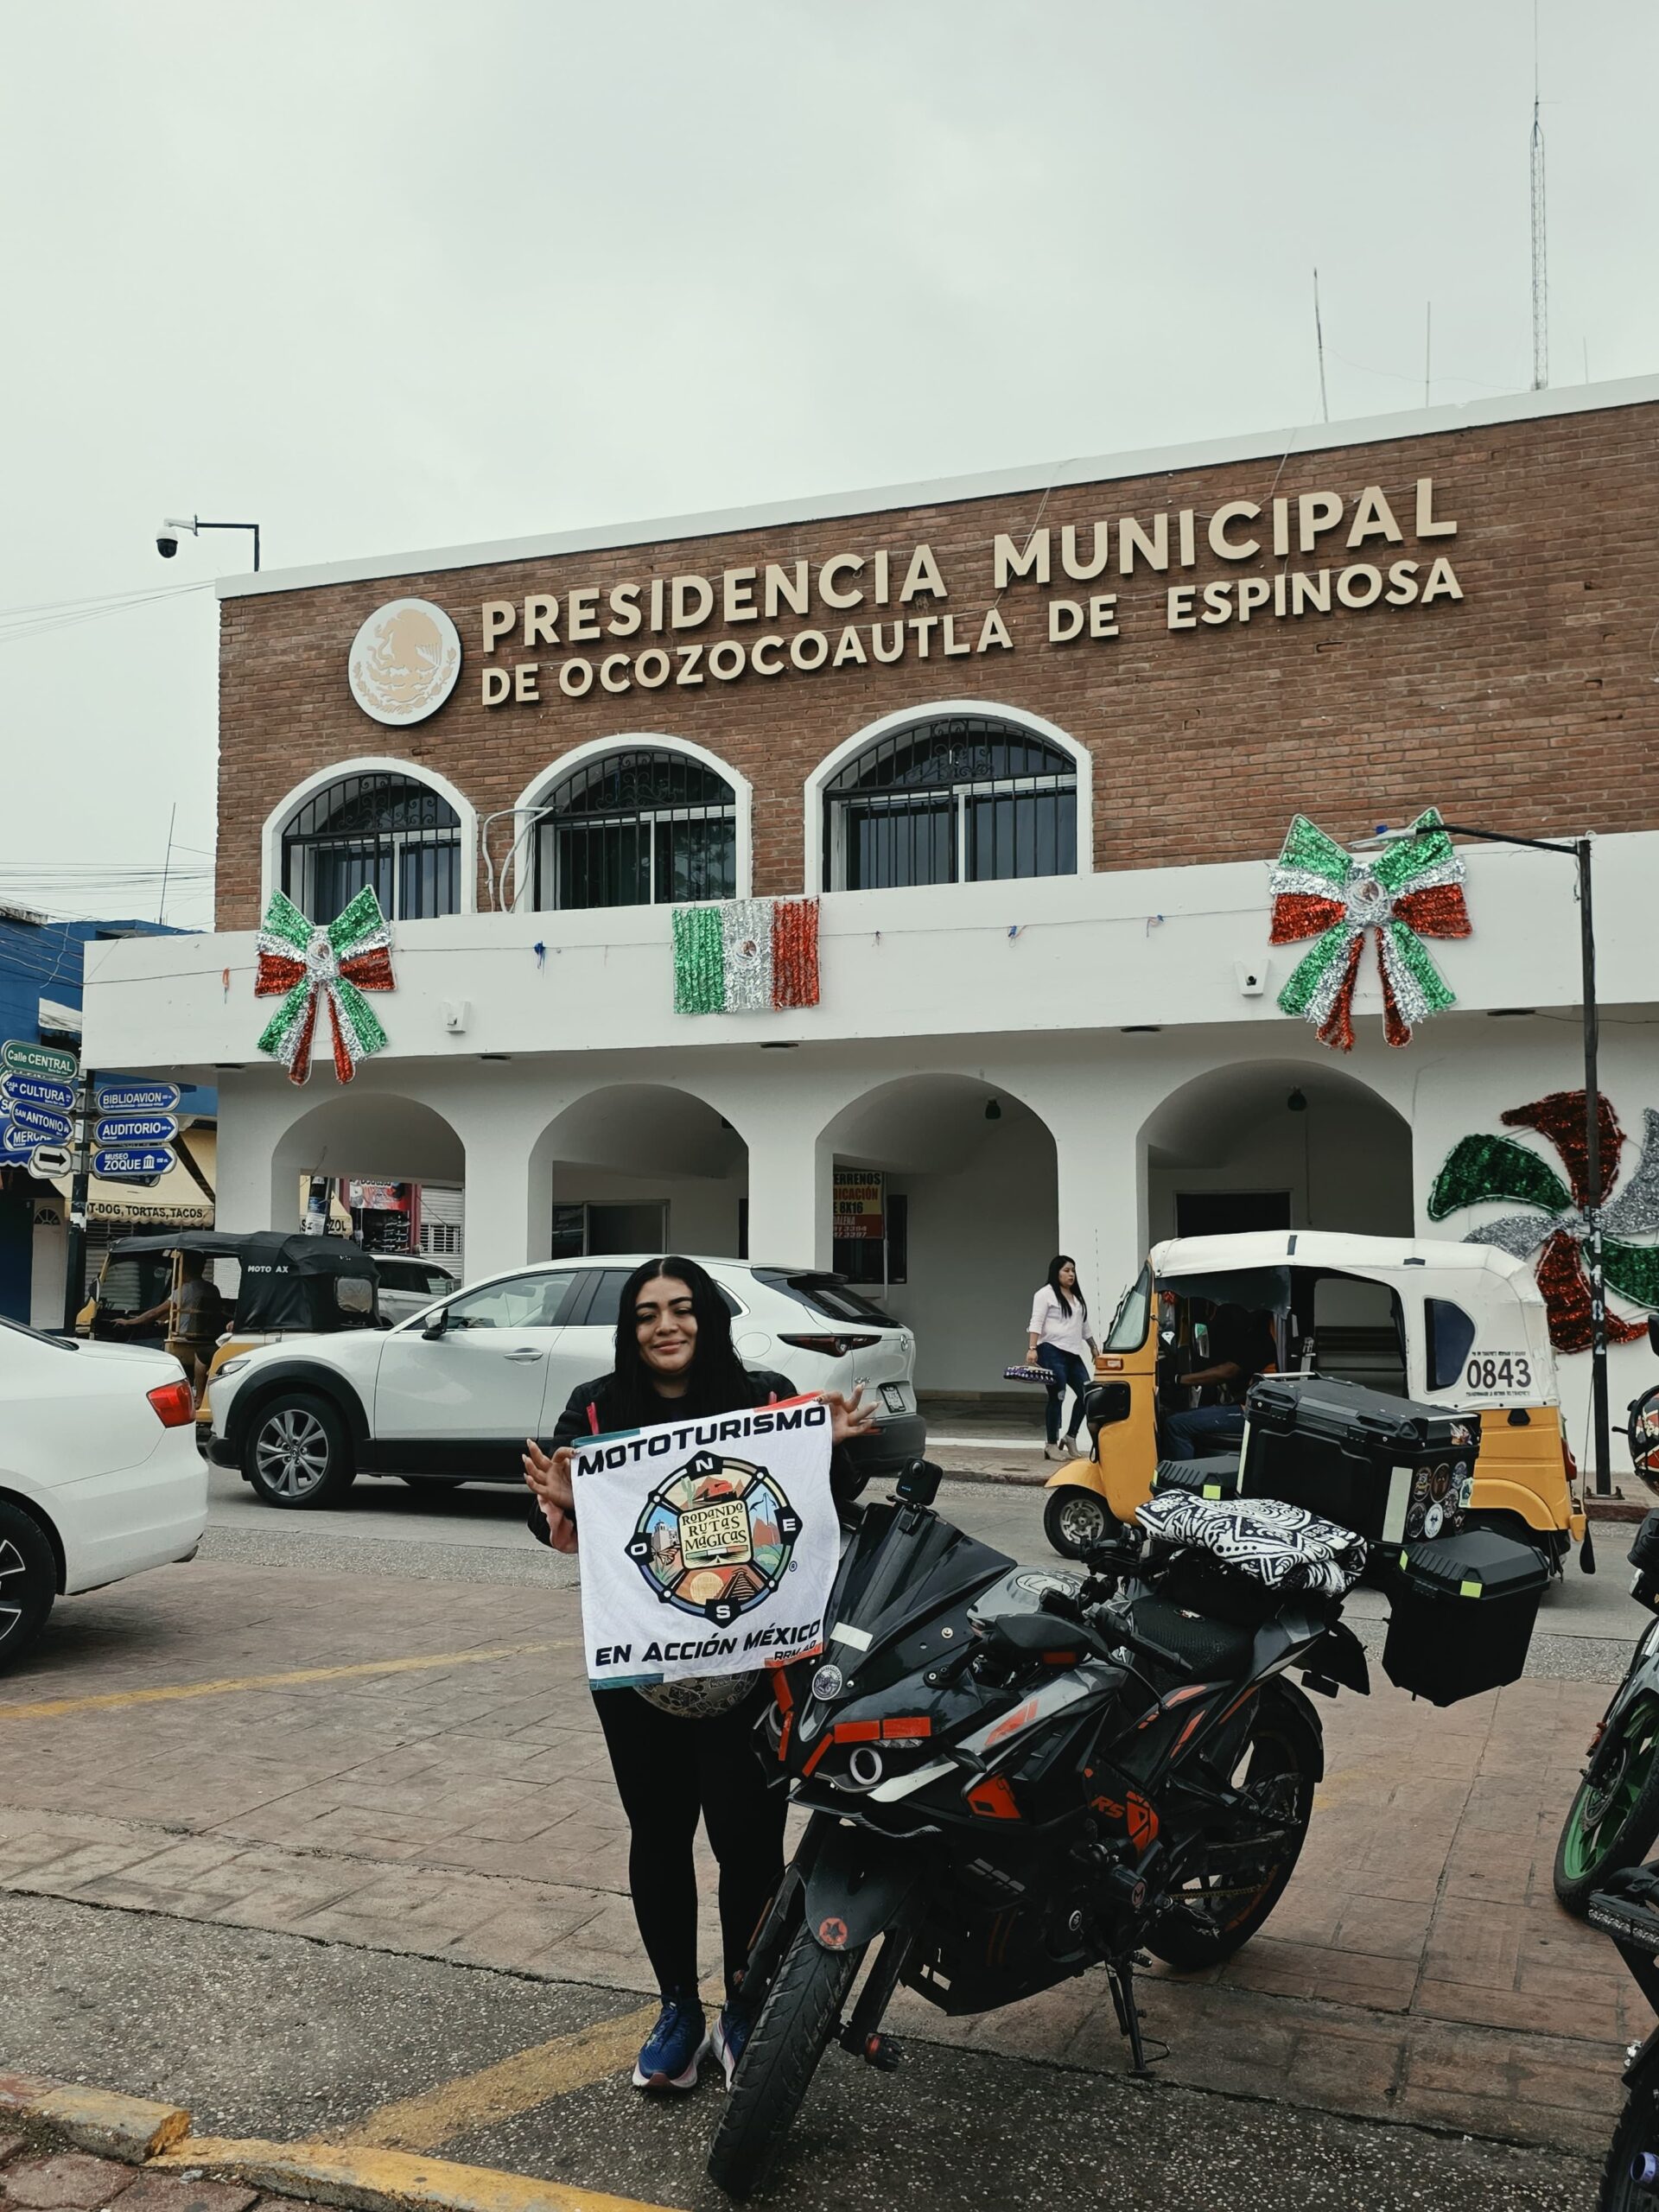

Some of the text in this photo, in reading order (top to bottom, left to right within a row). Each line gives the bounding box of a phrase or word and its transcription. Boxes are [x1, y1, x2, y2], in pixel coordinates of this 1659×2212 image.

[481, 478, 1458, 653] PRESIDENCIA MUNICIPAL
[482, 557, 1464, 705] DE OCOZOCOAUTLA DE ESPINOSA
[8, 1050, 27, 1063] Calle
[28, 1053, 73, 1071] CENTRAL
[19, 1083, 65, 1103] CULTURA
[103, 1092, 162, 1105] BIBLIOAVION
[15, 1108, 64, 1132] SAN ANTONIO
[102, 1122, 162, 1136] AUDITORIO
[104, 1159, 142, 1172] ZOQUE
[833, 1173, 881, 1185] ERRENOS
[247, 1265, 272, 1274] MOTO
[1466, 1358, 1532, 1389] 0843
[576, 1405, 826, 1477] MOTOTURISMO
[696, 1457, 714, 1472] N
[782, 1517, 797, 1532] E
[631, 1542, 648, 1554] O
[715, 1605, 731, 1619] S
[595, 1618, 821, 1667] EN ACCIÓN MÉXICO
[1090, 1795, 1125, 1819] RS
